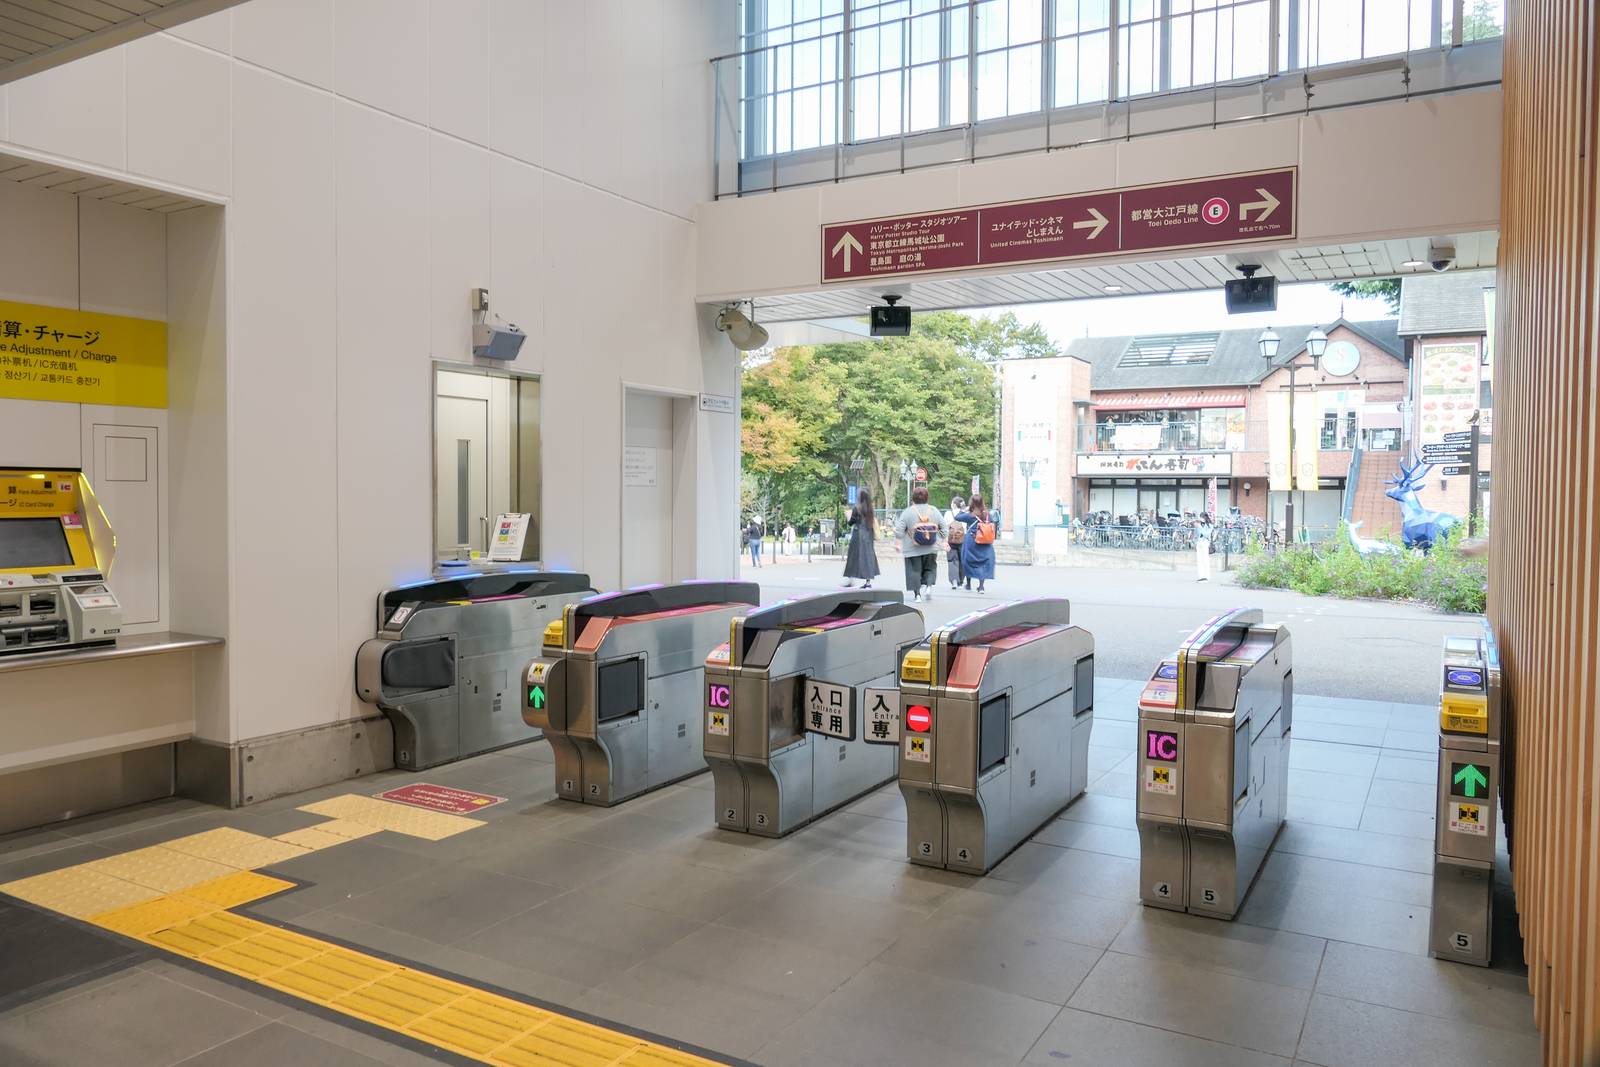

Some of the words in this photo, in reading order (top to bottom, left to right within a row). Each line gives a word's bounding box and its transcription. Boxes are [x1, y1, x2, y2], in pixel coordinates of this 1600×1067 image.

[1131, 204, 1199, 221] 都営大江戸線
[1212, 207, 1219, 216] E
[870, 221, 919, 233] ハリー・ポッター
[920, 216, 967, 228] スタジオツアー
[991, 216, 1064, 231] ユナイテッド・シネマ
[1164, 218, 1181, 226] Oedo
[1183, 216, 1199, 224] Line
[1026, 226, 1064, 238] としまえん
[870, 233, 945, 250] 東京都立練馬城址公園
[1033, 236, 1064, 244] Toshimaen
[886, 246, 918, 255] Metropolitan
[870, 255, 892, 266] 豊島園
[899, 253, 922, 263] 庭の湯
[0, 320, 100, 346] 算・チャージ
[10, 343, 71, 358] Adjustment
[80, 350, 118, 364] Charge
[4, 370, 31, 381] 정산기
[710, 685, 730, 707] IC
[810, 686, 843, 707] 入口
[812, 703, 842, 714] Entrance
[871, 694, 890, 712] 入
[810, 710, 843, 733] 専用
[871, 720, 890, 738] 専
[1148, 733, 1177, 760] IC
[402, 752, 407, 760] 1
[566, 781, 571, 789] 1
[591, 785, 598, 793] 2
[727, 809, 735, 819] 2
[758, 815, 765, 824] 3
[923, 843, 931, 853] 3
[959, 850, 967, 859] 4
[1159, 884, 1168, 895] 4
[1204, 890, 1214, 901] 5
[1456, 934, 1468, 947] 5
